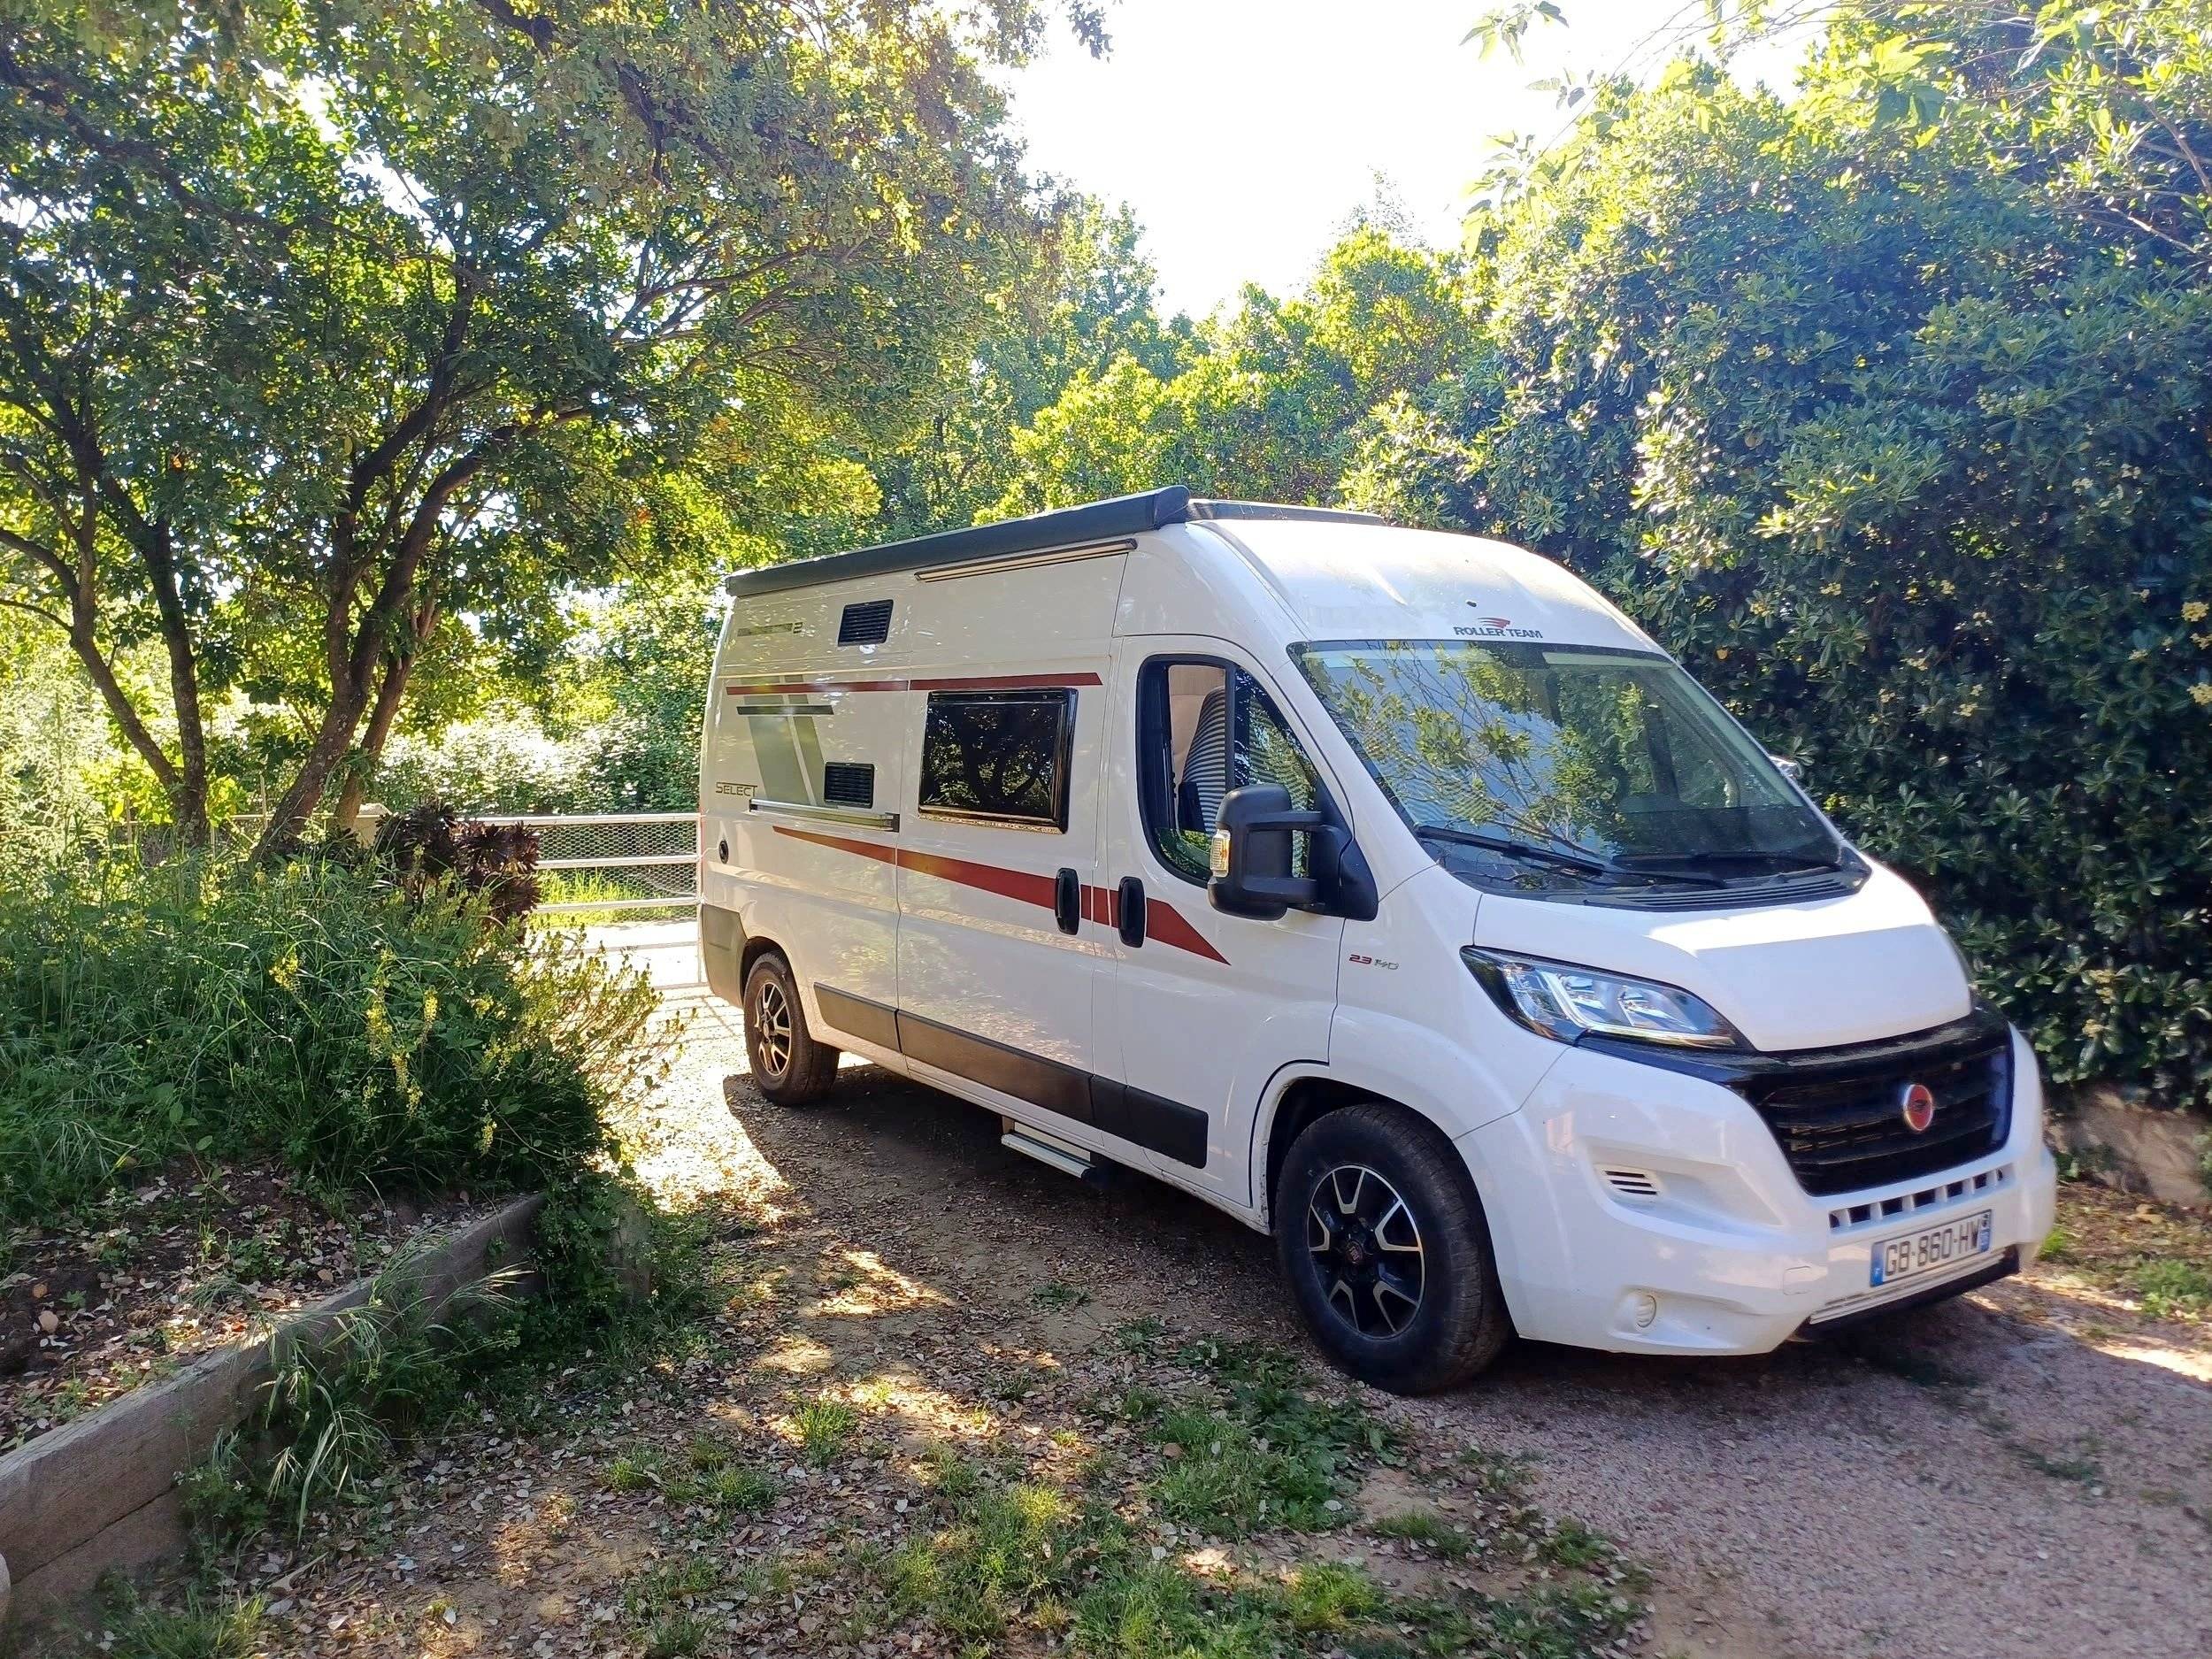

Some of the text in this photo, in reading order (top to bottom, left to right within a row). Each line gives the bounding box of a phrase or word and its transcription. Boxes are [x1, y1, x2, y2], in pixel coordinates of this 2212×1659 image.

[1453, 626, 1543, 638] ROLLER TEAM
[715, 781, 758, 797] SELECT
